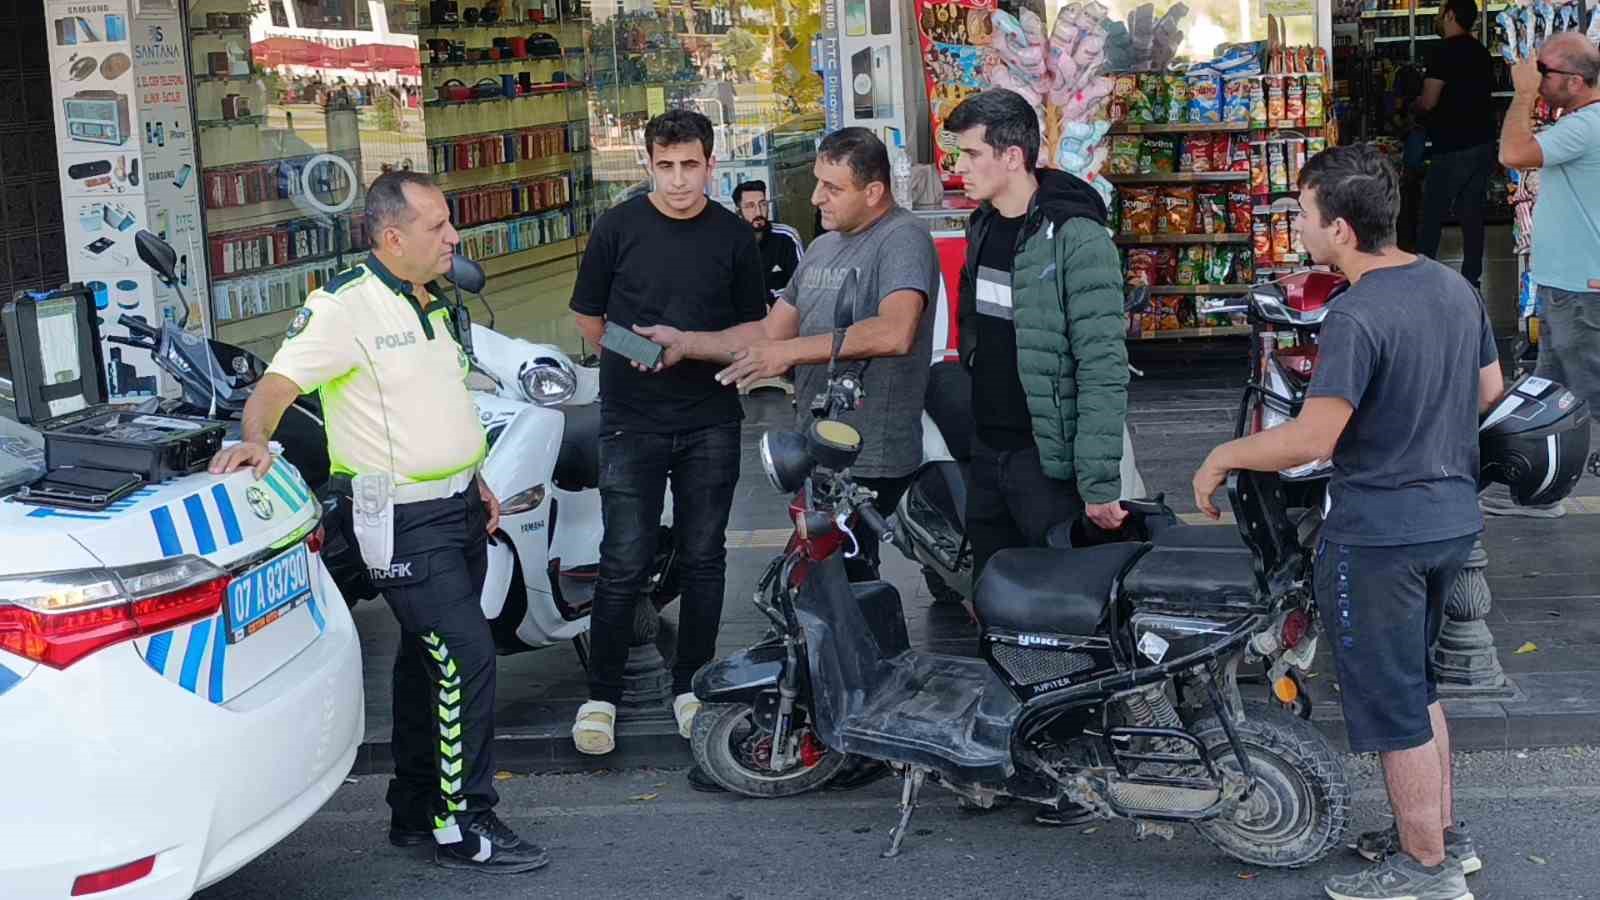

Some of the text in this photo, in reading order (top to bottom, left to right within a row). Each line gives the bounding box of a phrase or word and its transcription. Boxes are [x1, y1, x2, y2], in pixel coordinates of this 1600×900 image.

[68, 5, 109, 13] SAMSUNG
[136, 45, 180, 58] SANTANA
[235, 550, 306, 622] 07 A 83790
[1033, 678, 1071, 692] JUPITER
